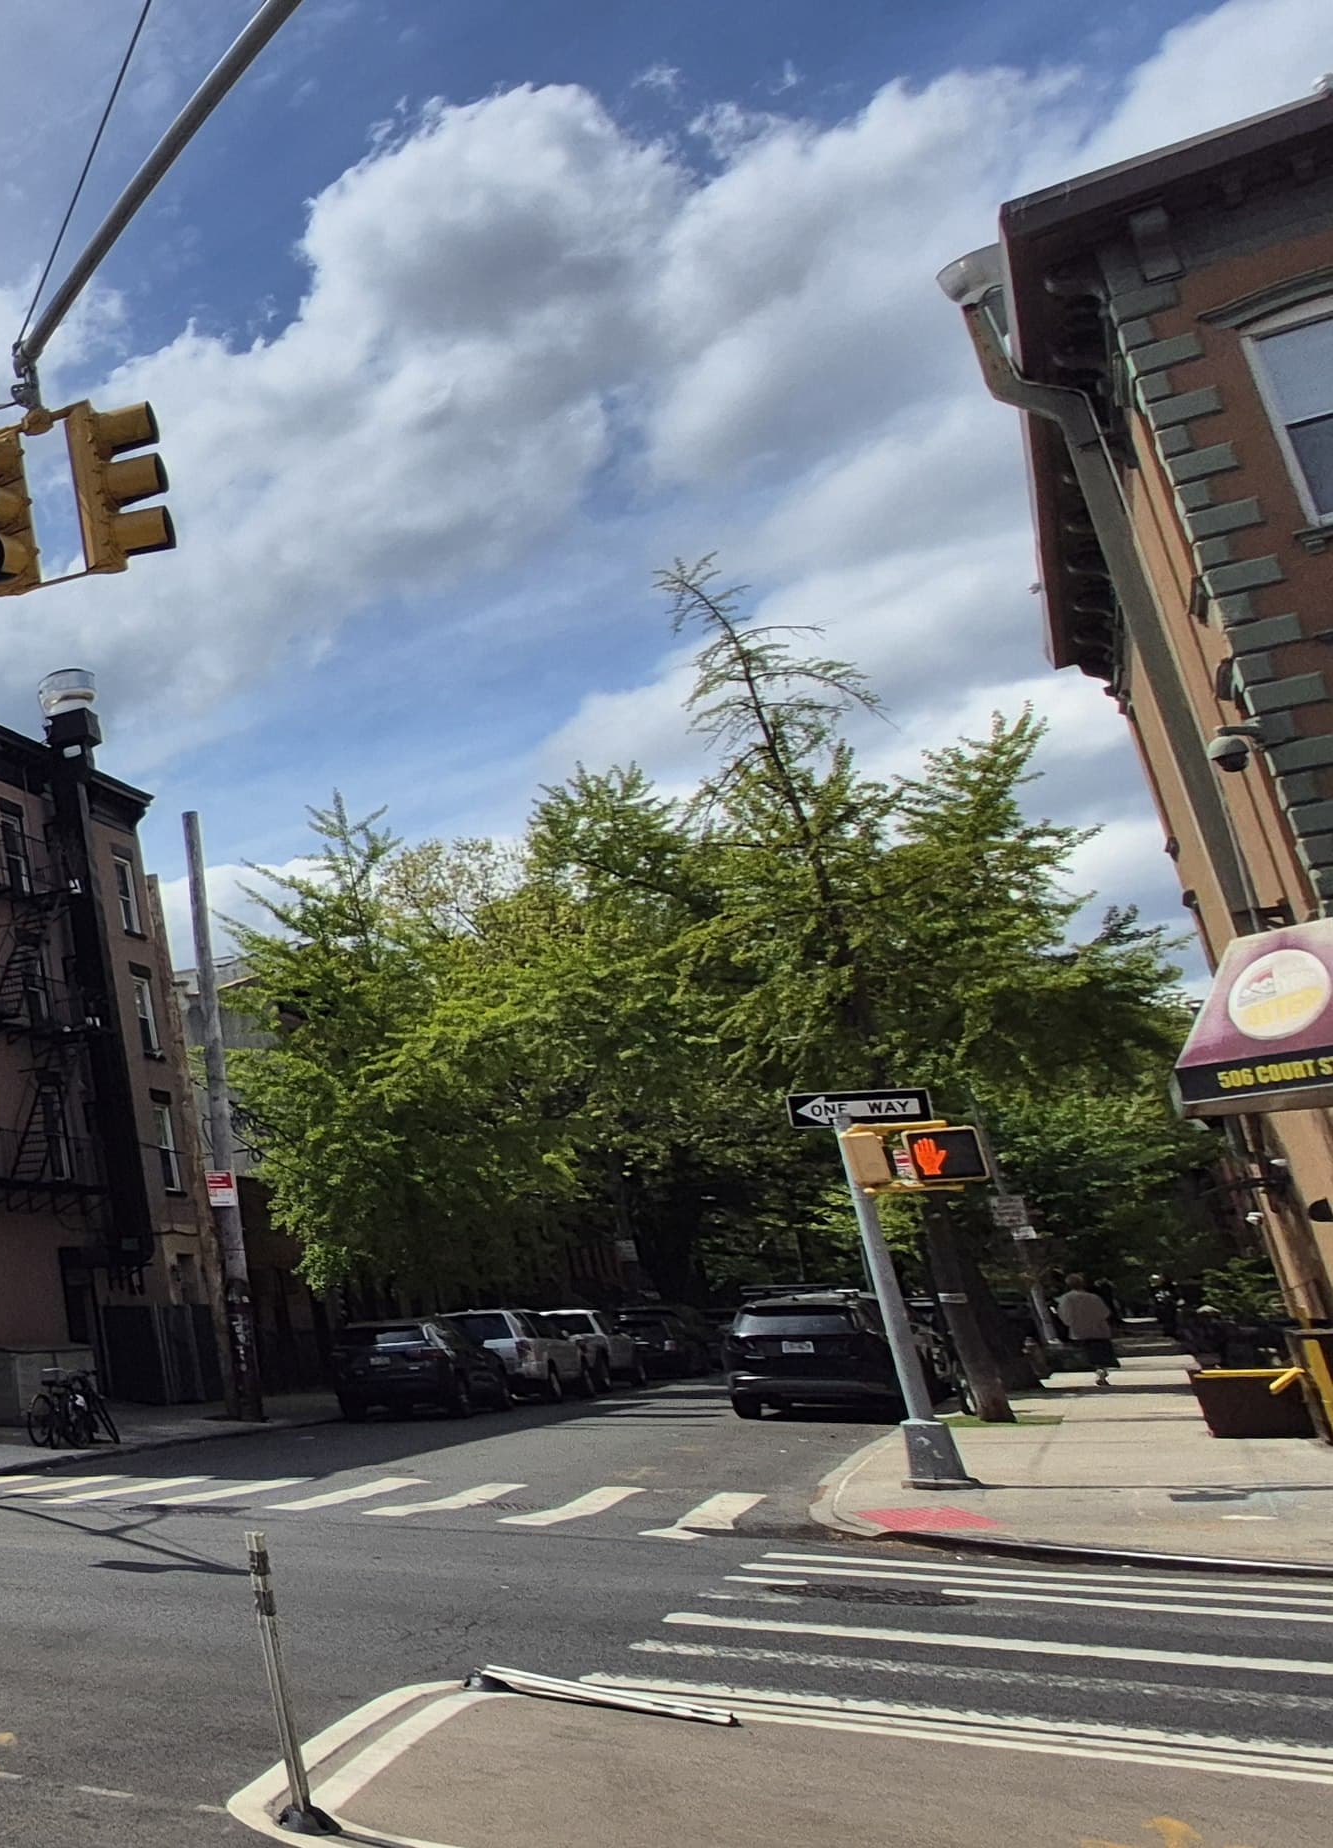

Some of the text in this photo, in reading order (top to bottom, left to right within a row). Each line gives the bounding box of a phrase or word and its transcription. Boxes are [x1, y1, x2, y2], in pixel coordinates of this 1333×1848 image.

[1217, 1068, 1254, 1088] 506
[1255, 1059, 1316, 1084] COURT
[811, 1101, 909, 1116] ONE WAY
